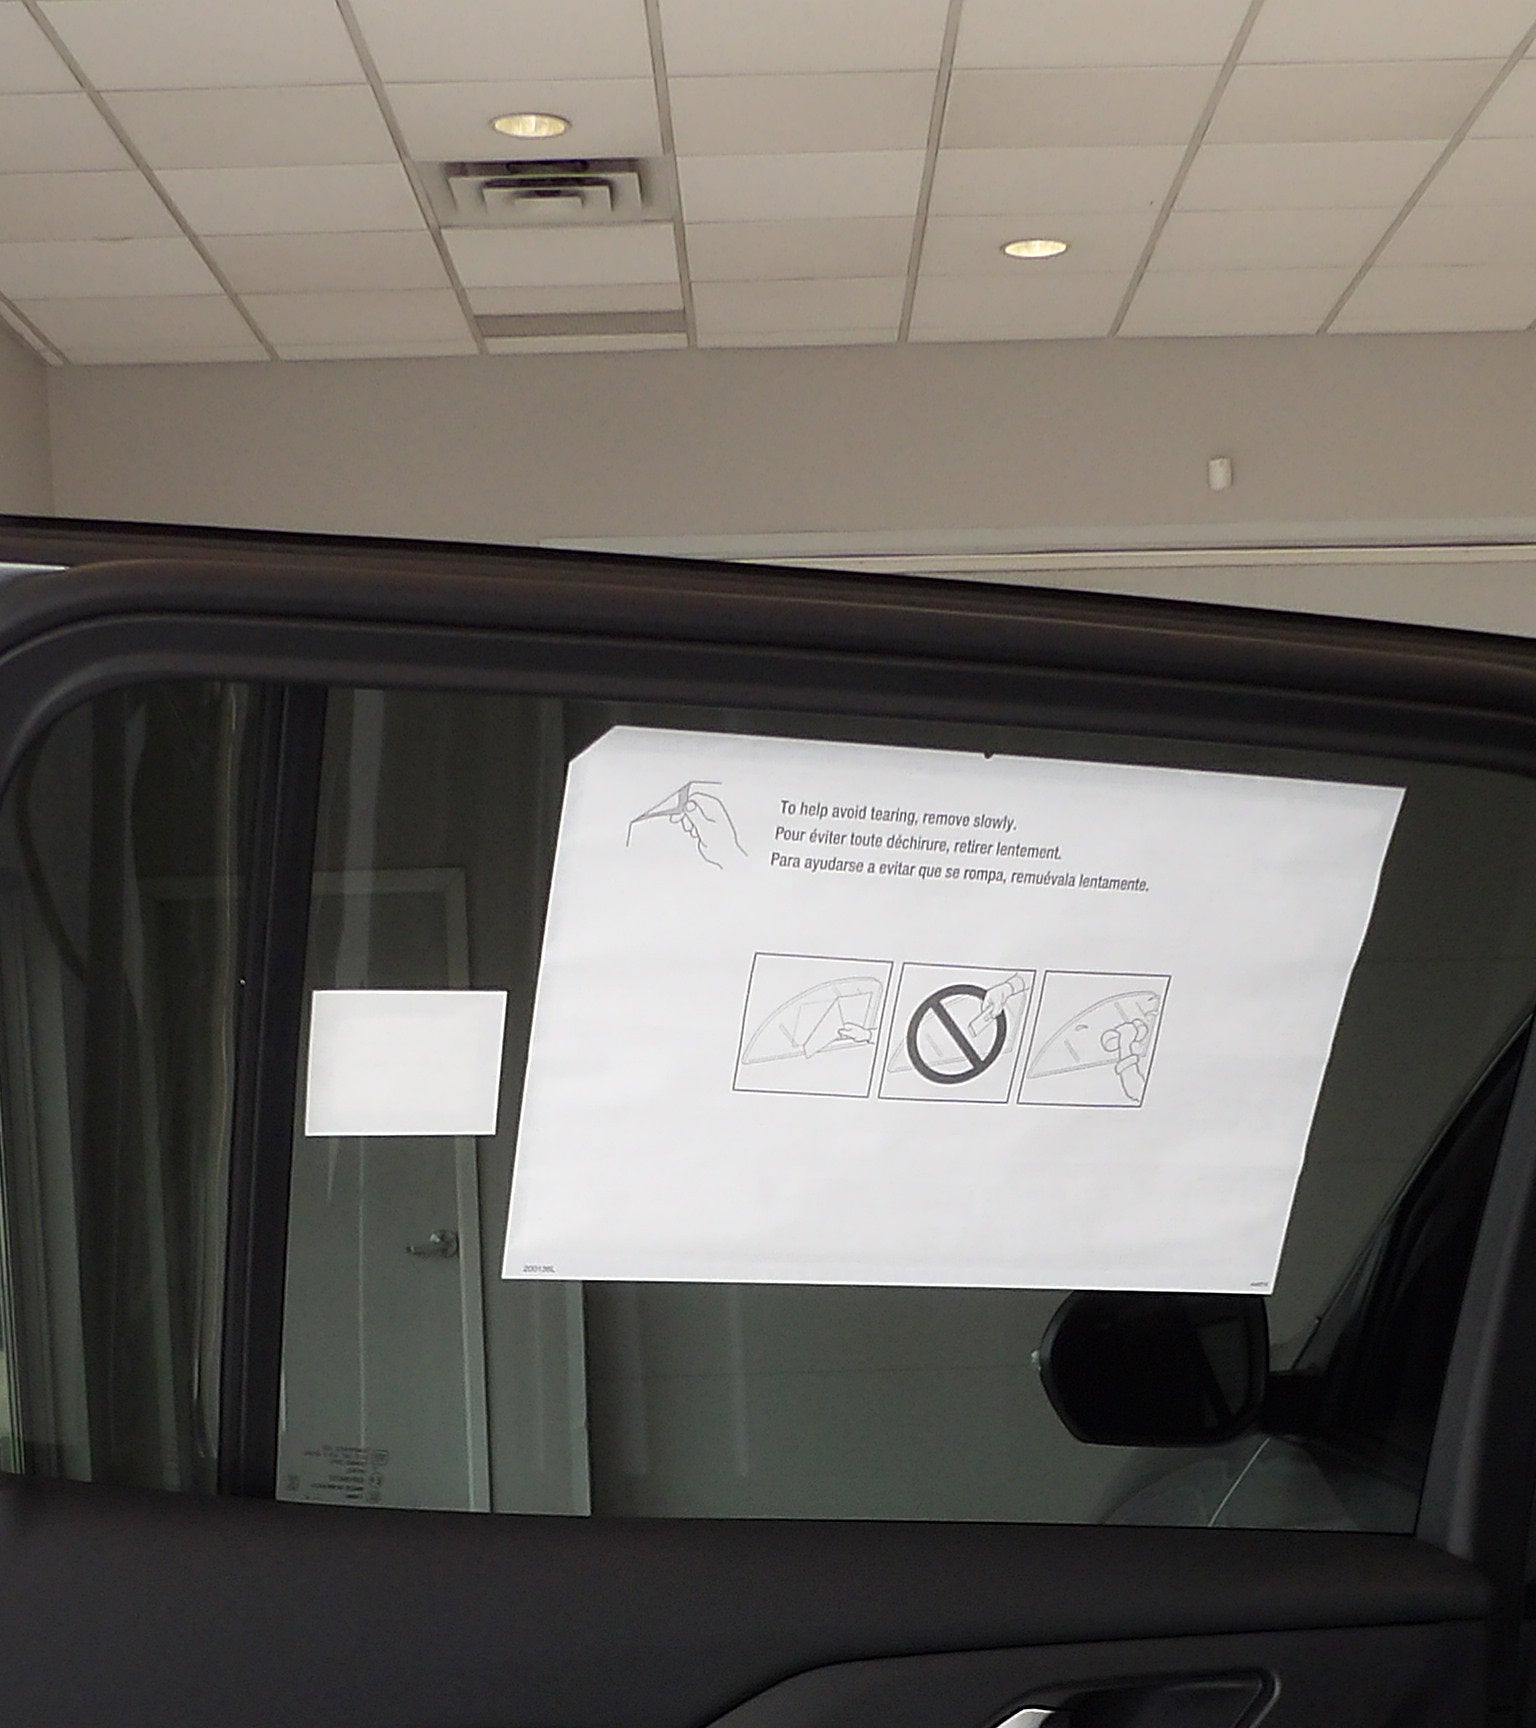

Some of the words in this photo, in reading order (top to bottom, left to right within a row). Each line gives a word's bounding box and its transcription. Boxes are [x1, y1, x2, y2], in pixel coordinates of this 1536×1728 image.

[781, 800, 796, 815] To
[800, 802, 828, 820] help
[832, 804, 867, 820] avoid
[871, 807, 919, 826] tearing,
[922, 812, 971, 827] remove
[973, 814, 1017, 833] slowly.
[775, 826, 806, 841] Pour
[810, 828, 848, 845] éviter
[850, 833, 882, 848] toute
[886, 835, 950, 854] déchirure,
[953, 840, 994, 855] retirer
[996, 841, 1061, 860] lentement.
[770, 852, 801, 868] Para
[804, 857, 864, 874] ayudarse
[867, 863, 875, 873] a
[879, 861, 915, 876] evitar
[918, 865, 942, 880] que
[945, 868, 960, 879] se
[963, 867, 1006, 884] rompa,
[1010, 870, 1076, 887] remuévala
[1078, 874, 1149, 892] lentamente.
